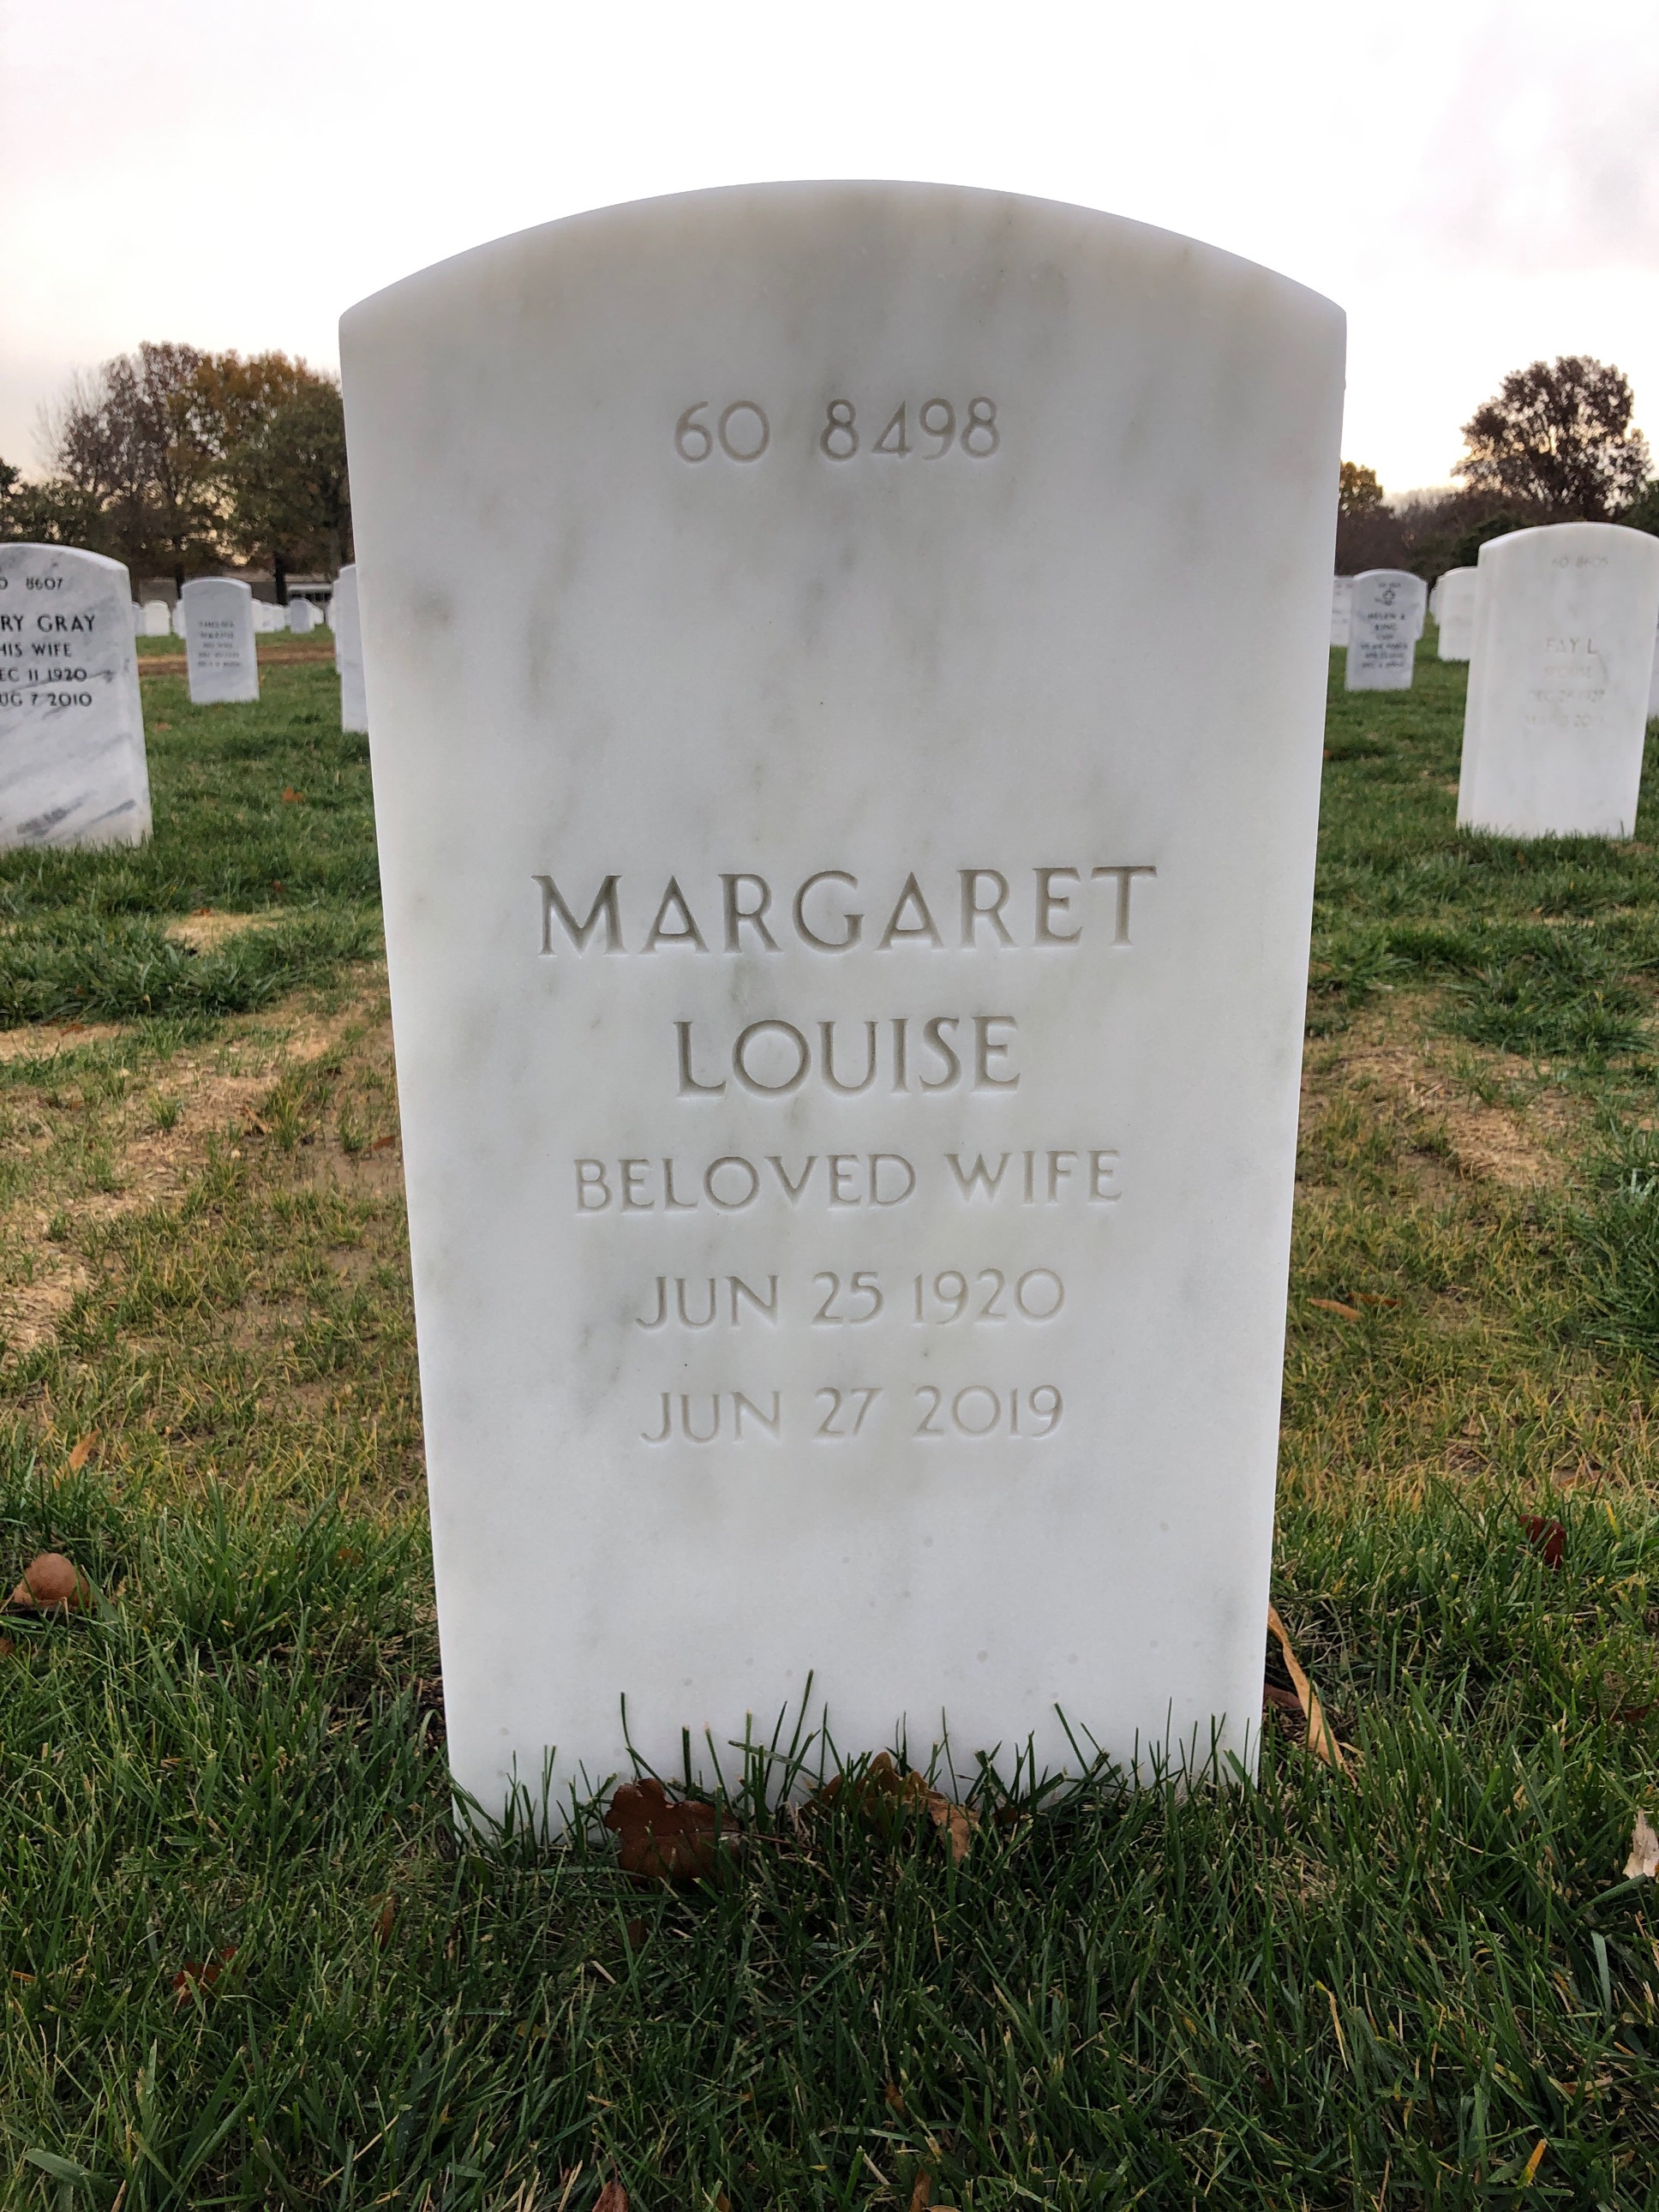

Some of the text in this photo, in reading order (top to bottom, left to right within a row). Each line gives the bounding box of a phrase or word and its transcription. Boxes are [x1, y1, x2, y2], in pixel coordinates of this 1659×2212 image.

[674, 397, 1000, 463] 60 8498
[32, 643, 72, 657] WIFE
[37, 614, 96, 632] GRAY
[1546, 637, 1599, 654] FAY L
[28, 668, 39, 681] 11
[48, 668, 87, 682] 1920
[31, 693, 39, 705] 7
[48, 692, 93, 707] 2010
[530, 865, 1159, 956] MARGARET
[673, 1015, 1021, 1098] LOUISE
[572, 1149, 1123, 1214] BELOVED WIFE
[635, 1268, 1066, 1330] JUN 25 1920
[640, 1384, 1065, 1446] JUN 27 2019
